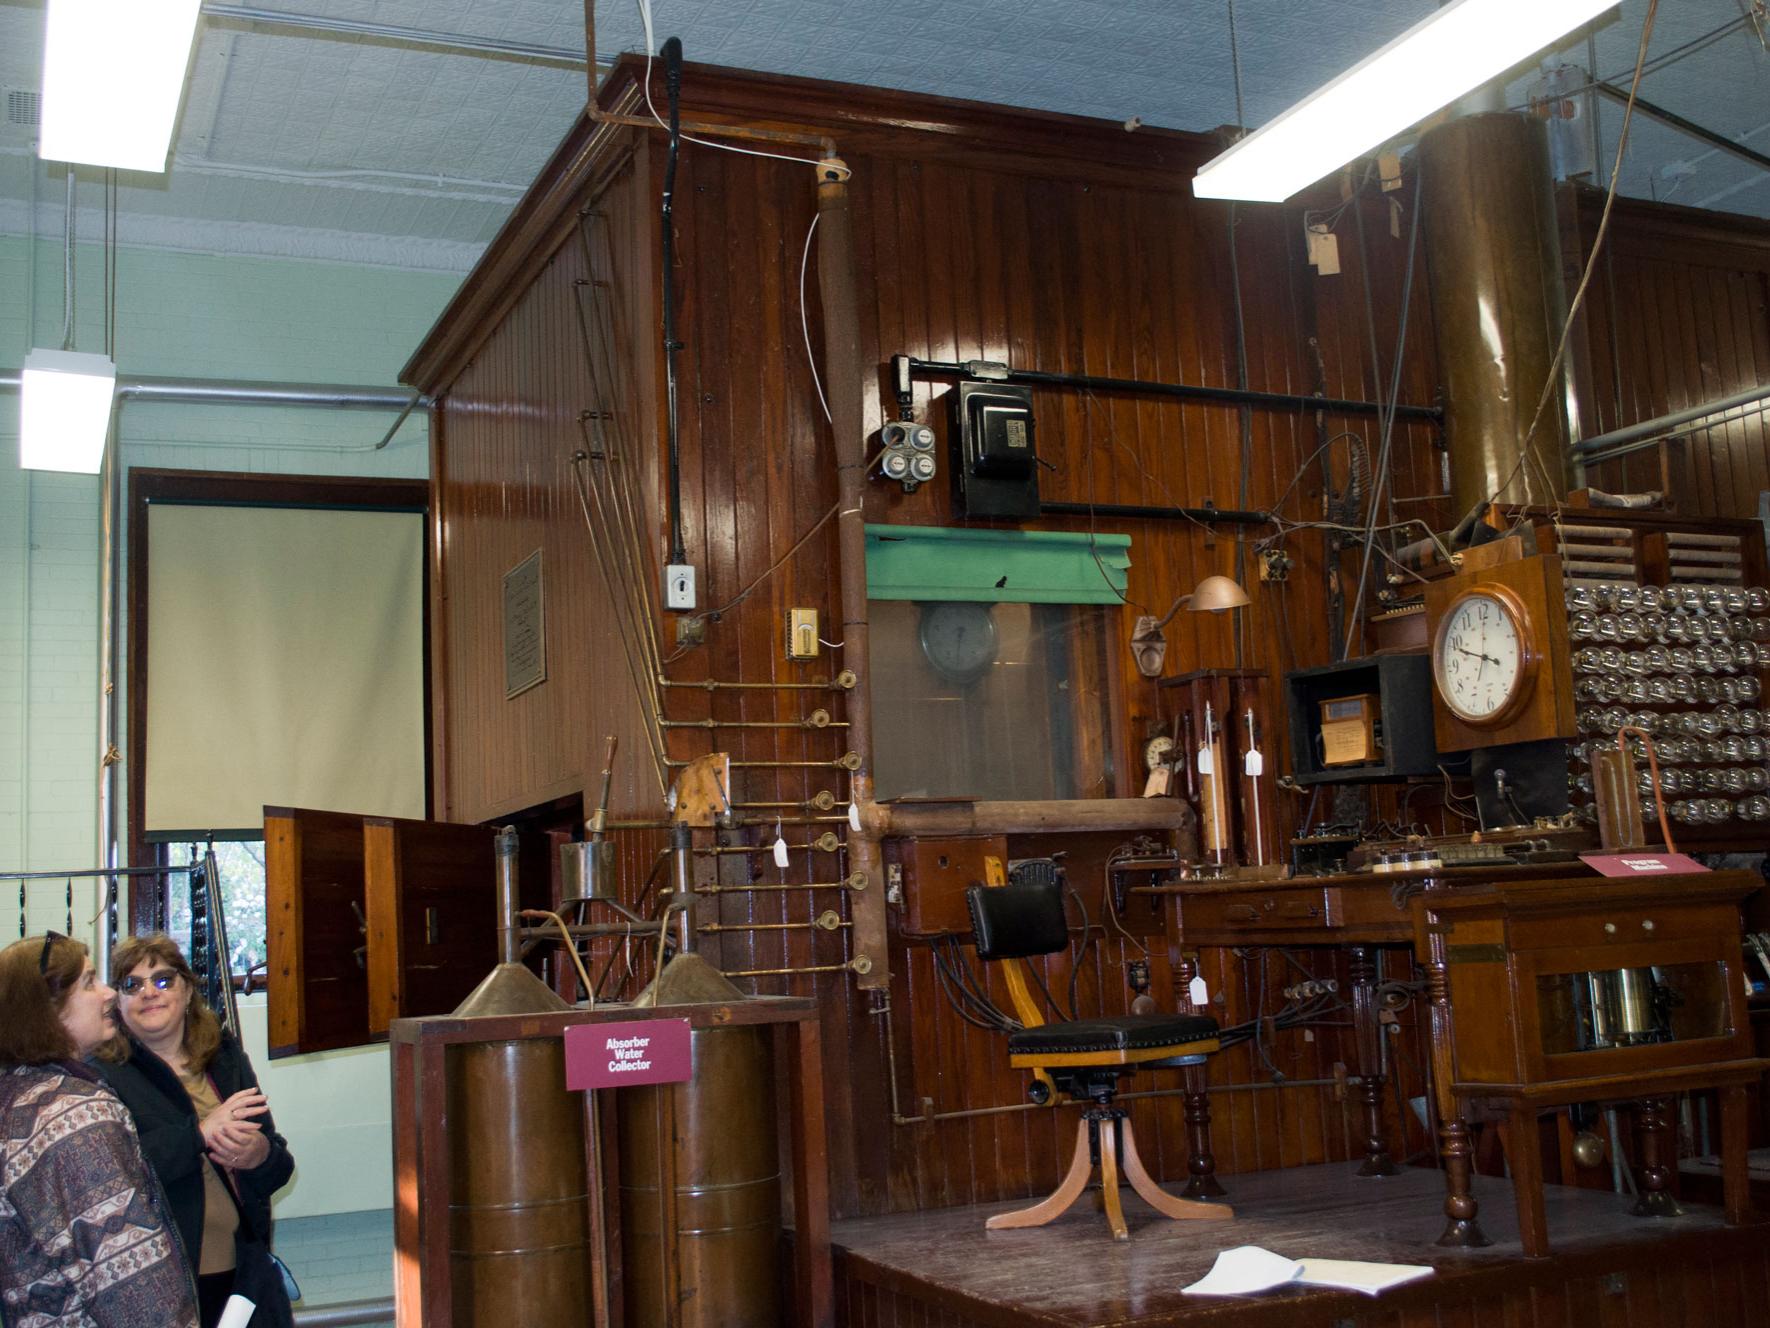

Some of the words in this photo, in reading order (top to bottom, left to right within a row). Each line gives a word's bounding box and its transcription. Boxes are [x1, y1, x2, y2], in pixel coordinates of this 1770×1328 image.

[1478, 603, 1488, 620] 12
[606, 1036, 650, 1050] Absorber
[614, 1048, 644, 1060] Water
[608, 1059, 652, 1072] Collector
